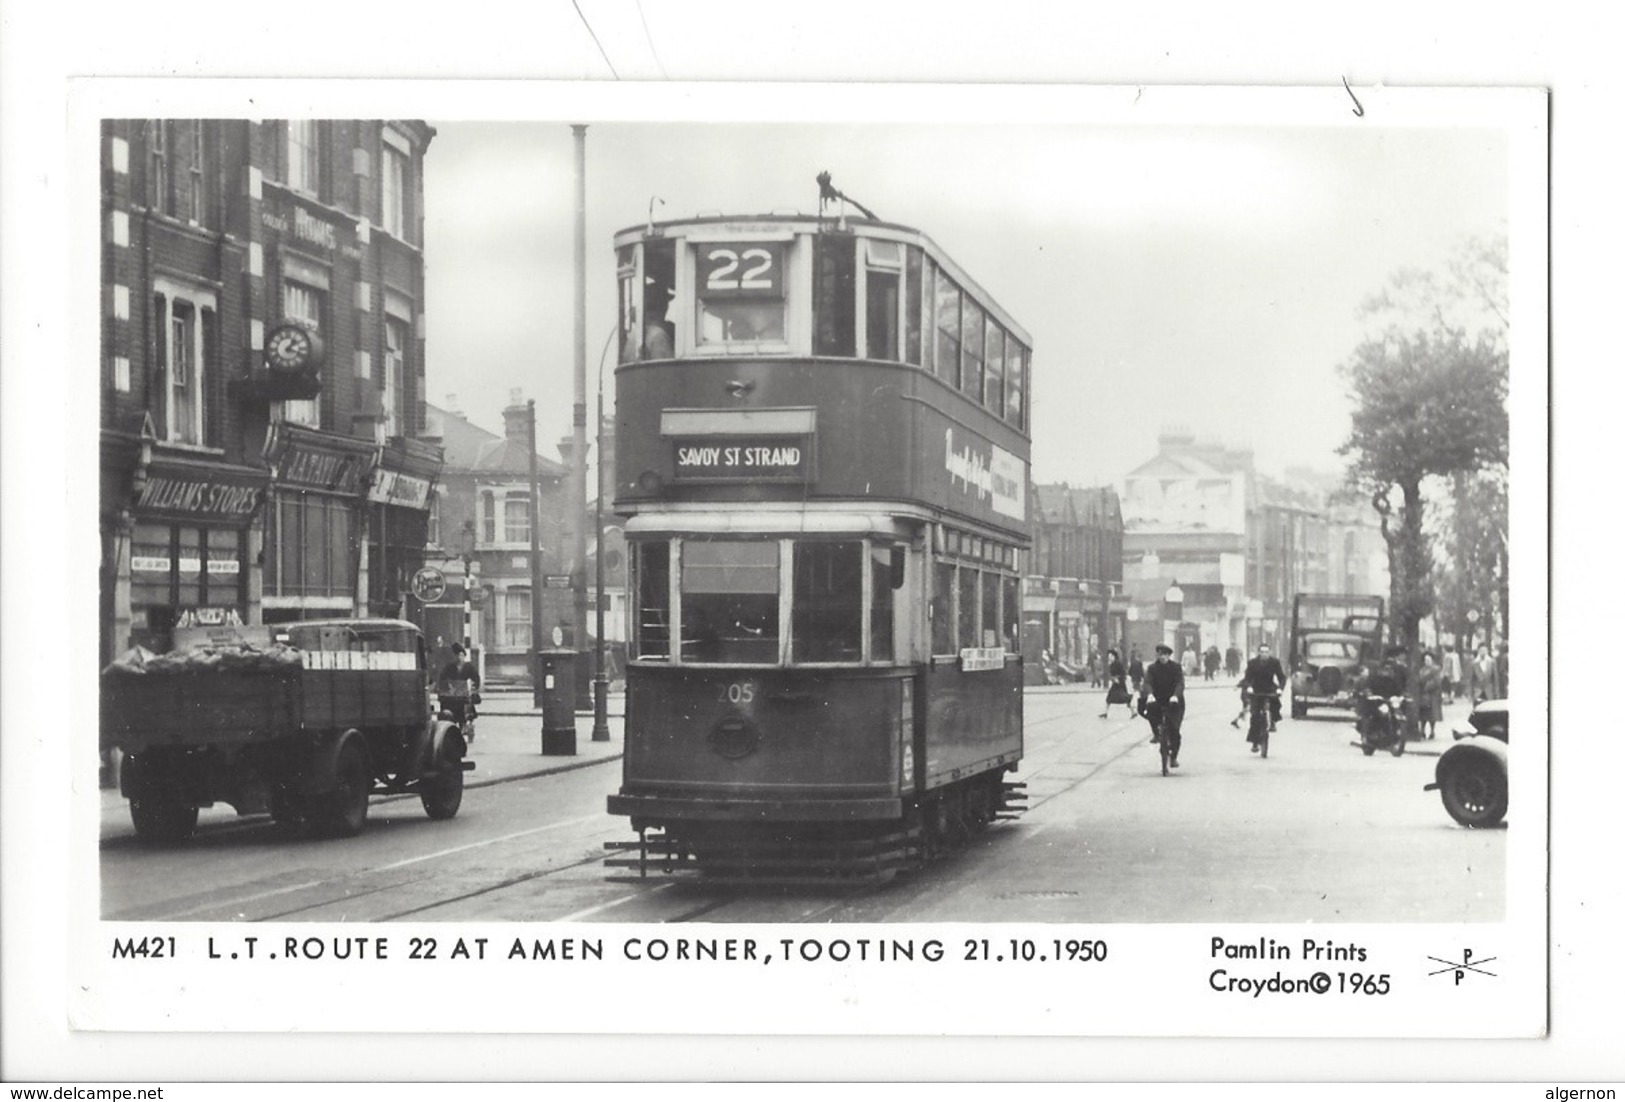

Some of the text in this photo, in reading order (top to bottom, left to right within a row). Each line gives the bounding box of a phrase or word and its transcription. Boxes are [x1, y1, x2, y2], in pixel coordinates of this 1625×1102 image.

[707, 248, 773, 290] 22
[678, 447, 800, 466] SAVOY ST STRAND
[138, 477, 261, 514] WILLIAMS STORES
[716, 683, 754, 703] 205
